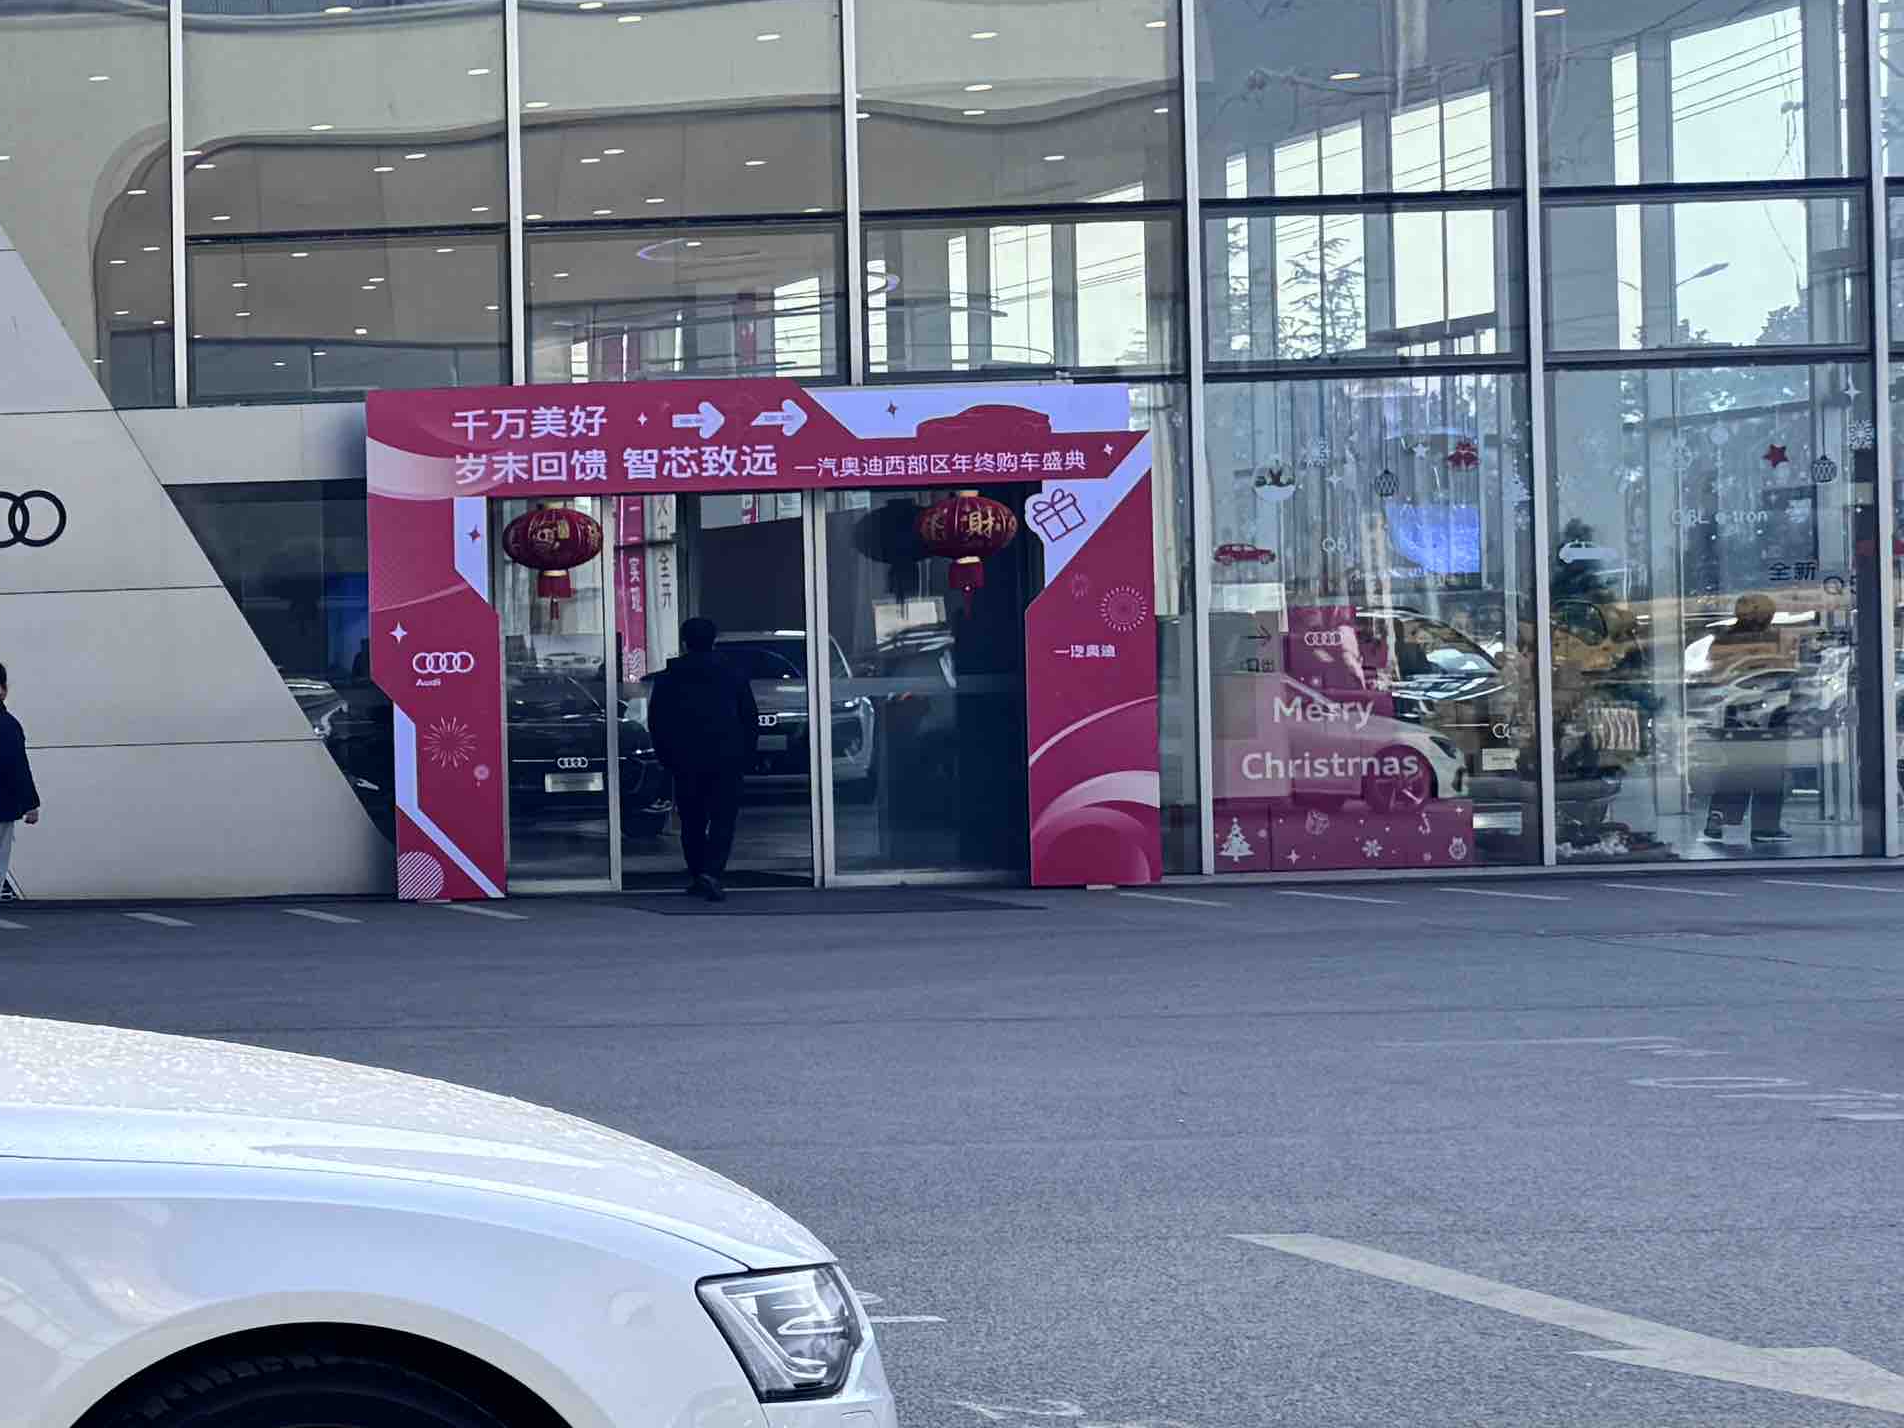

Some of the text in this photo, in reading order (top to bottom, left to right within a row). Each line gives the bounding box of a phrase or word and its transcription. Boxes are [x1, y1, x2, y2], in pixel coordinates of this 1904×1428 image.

[451, 405, 607, 441] 千万美好
[455, 444, 1087, 484] 岁末回馈 智芯致远 一汽奥迪西部区年终购车盛典
[1273, 696, 1375, 732] Merry
[1241, 752, 1419, 780] Christmas
